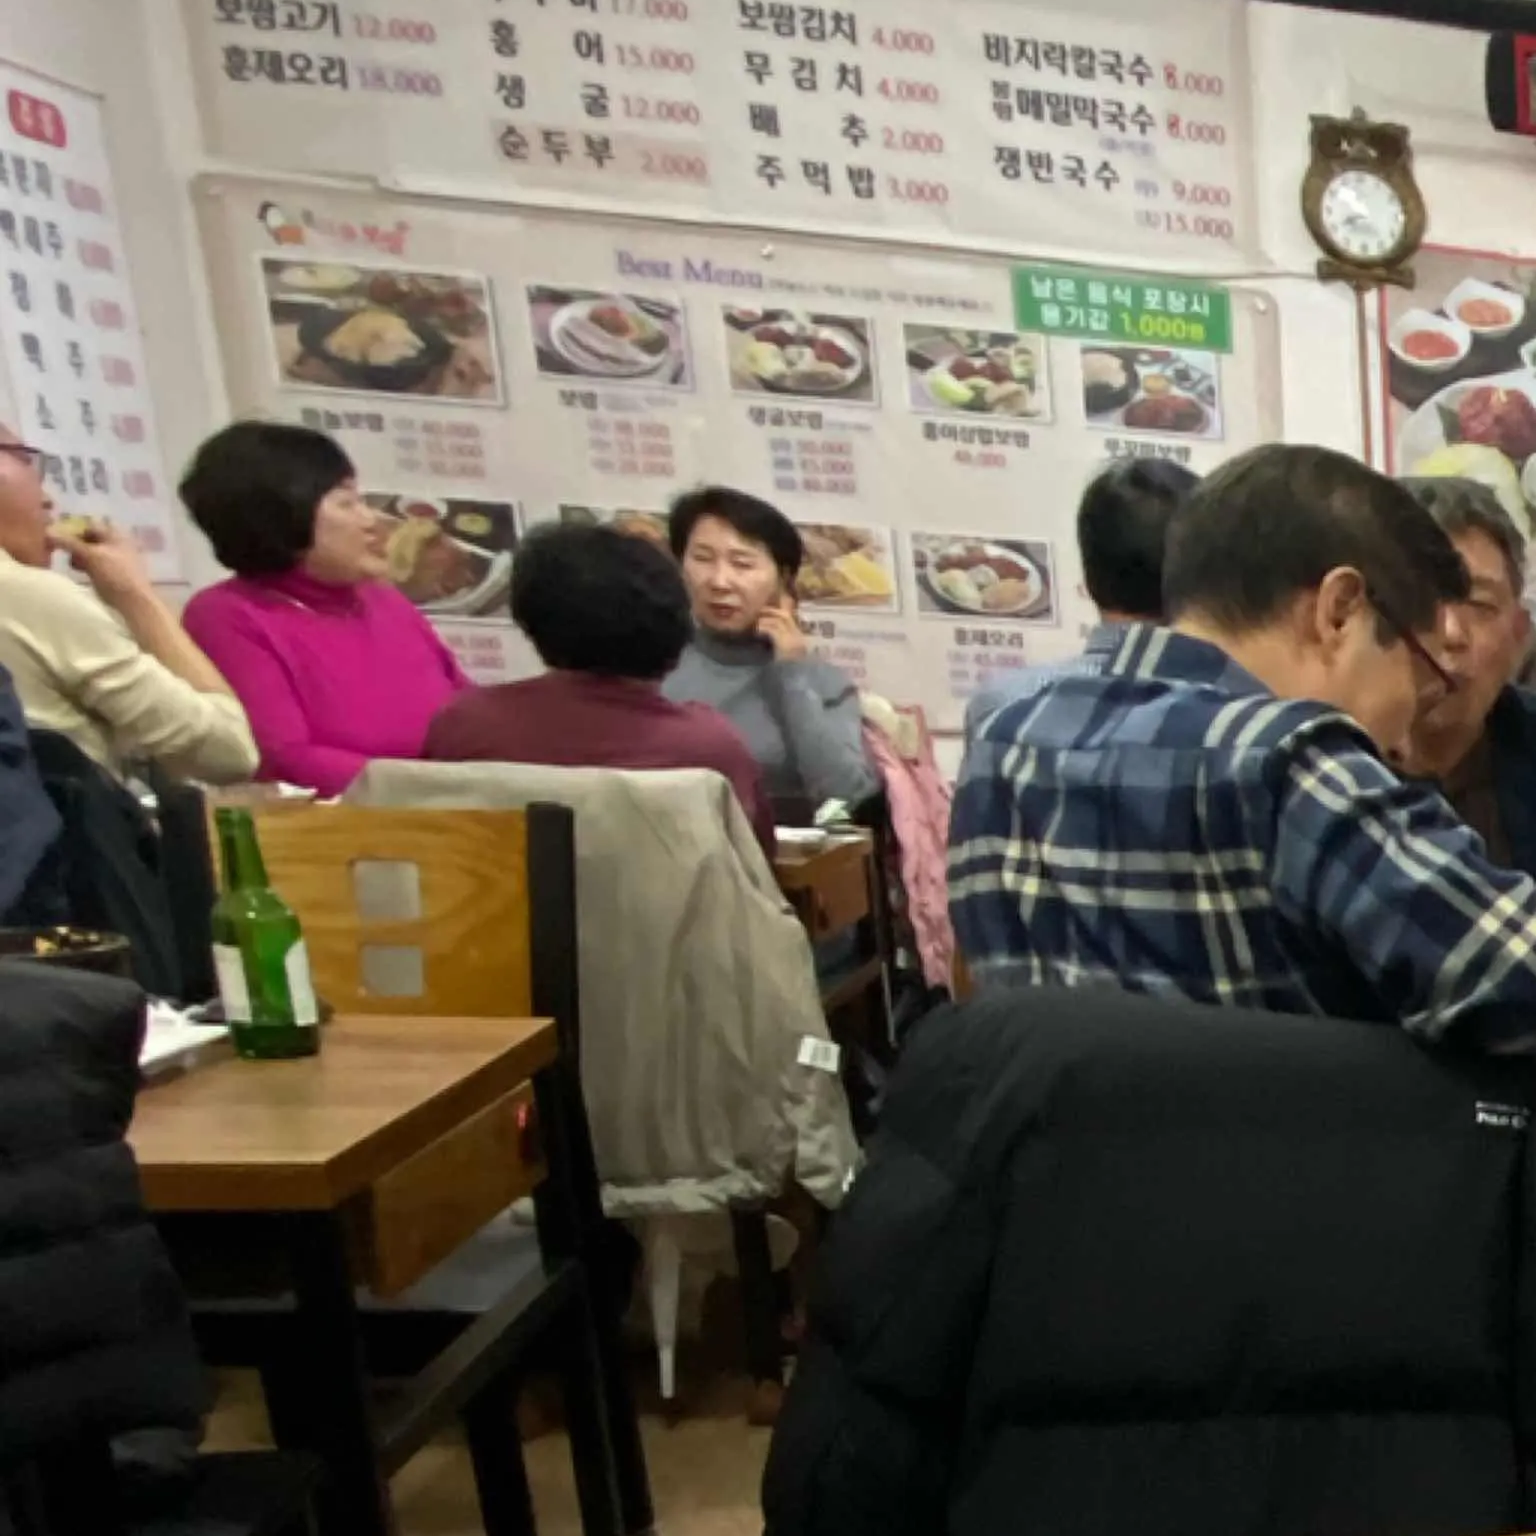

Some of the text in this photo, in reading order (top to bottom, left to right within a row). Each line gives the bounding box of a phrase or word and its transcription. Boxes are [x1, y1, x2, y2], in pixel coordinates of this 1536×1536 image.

[983, 32, 1153, 86] 바지락칼국수
[994, 146, 1119, 191] 쟁반국수
[615, 248, 763, 288] Best Menu
[1030, 274, 1077, 301] 남은
